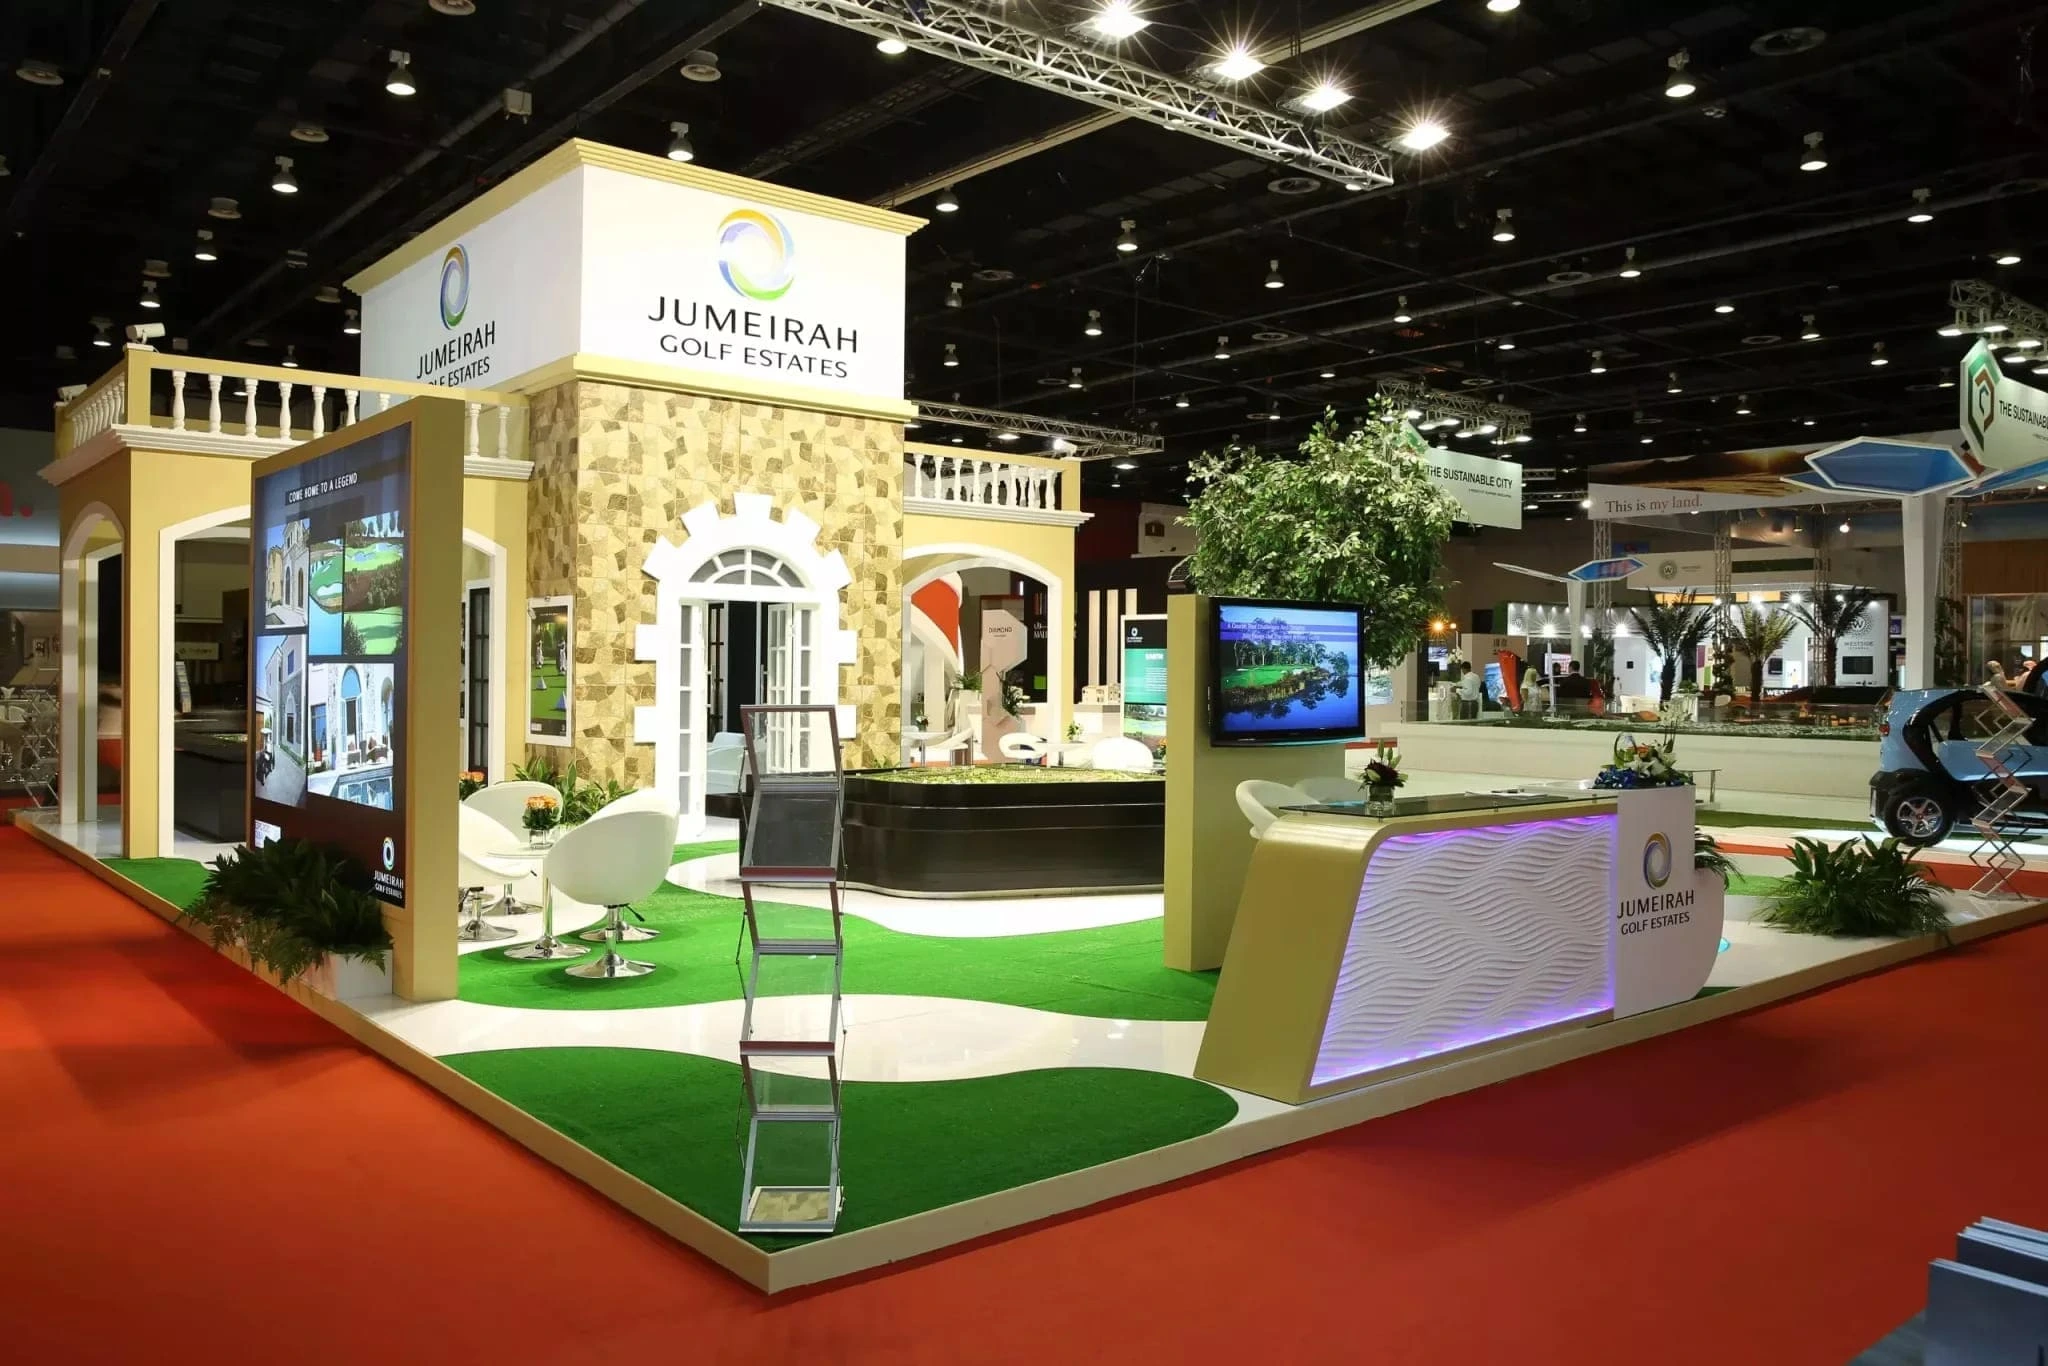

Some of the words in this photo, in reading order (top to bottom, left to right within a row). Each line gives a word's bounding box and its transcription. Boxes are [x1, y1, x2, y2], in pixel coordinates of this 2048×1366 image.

[648, 296, 857, 353] JUMEIRAH
[416, 320, 495, 379] JUMEIRAH
[660, 334, 733, 360] GOLF
[744, 347, 848, 378] ESTATES
[448, 356, 490, 387] ESTATES
[1999, 400, 2012, 417] THE
[2013, 405, 2048, 430] SUSTAINAB
[288, 489, 303, 503] COME
[320, 482, 328, 494] TO
[329, 479, 334, 491] A
[335, 472, 358, 489] LEGEND
[1427, 465, 1441, 478] THE
[1443, 467, 1495, 487] SUSTAINABLE
[1496, 477, 1513, 489] CITY
[1605, 499, 1632, 513] This
[1636, 499, 1646, 511] is
[1650, 500, 1668, 513] my
[1672, 494, 1703, 509] land.
[374, 870, 404, 889] JUMEIRAH
[1616, 889, 1695, 919] JUMEIRAH
[1621, 919, 1649, 935] GOLF
[1651, 911, 1690, 930] ESTATES
